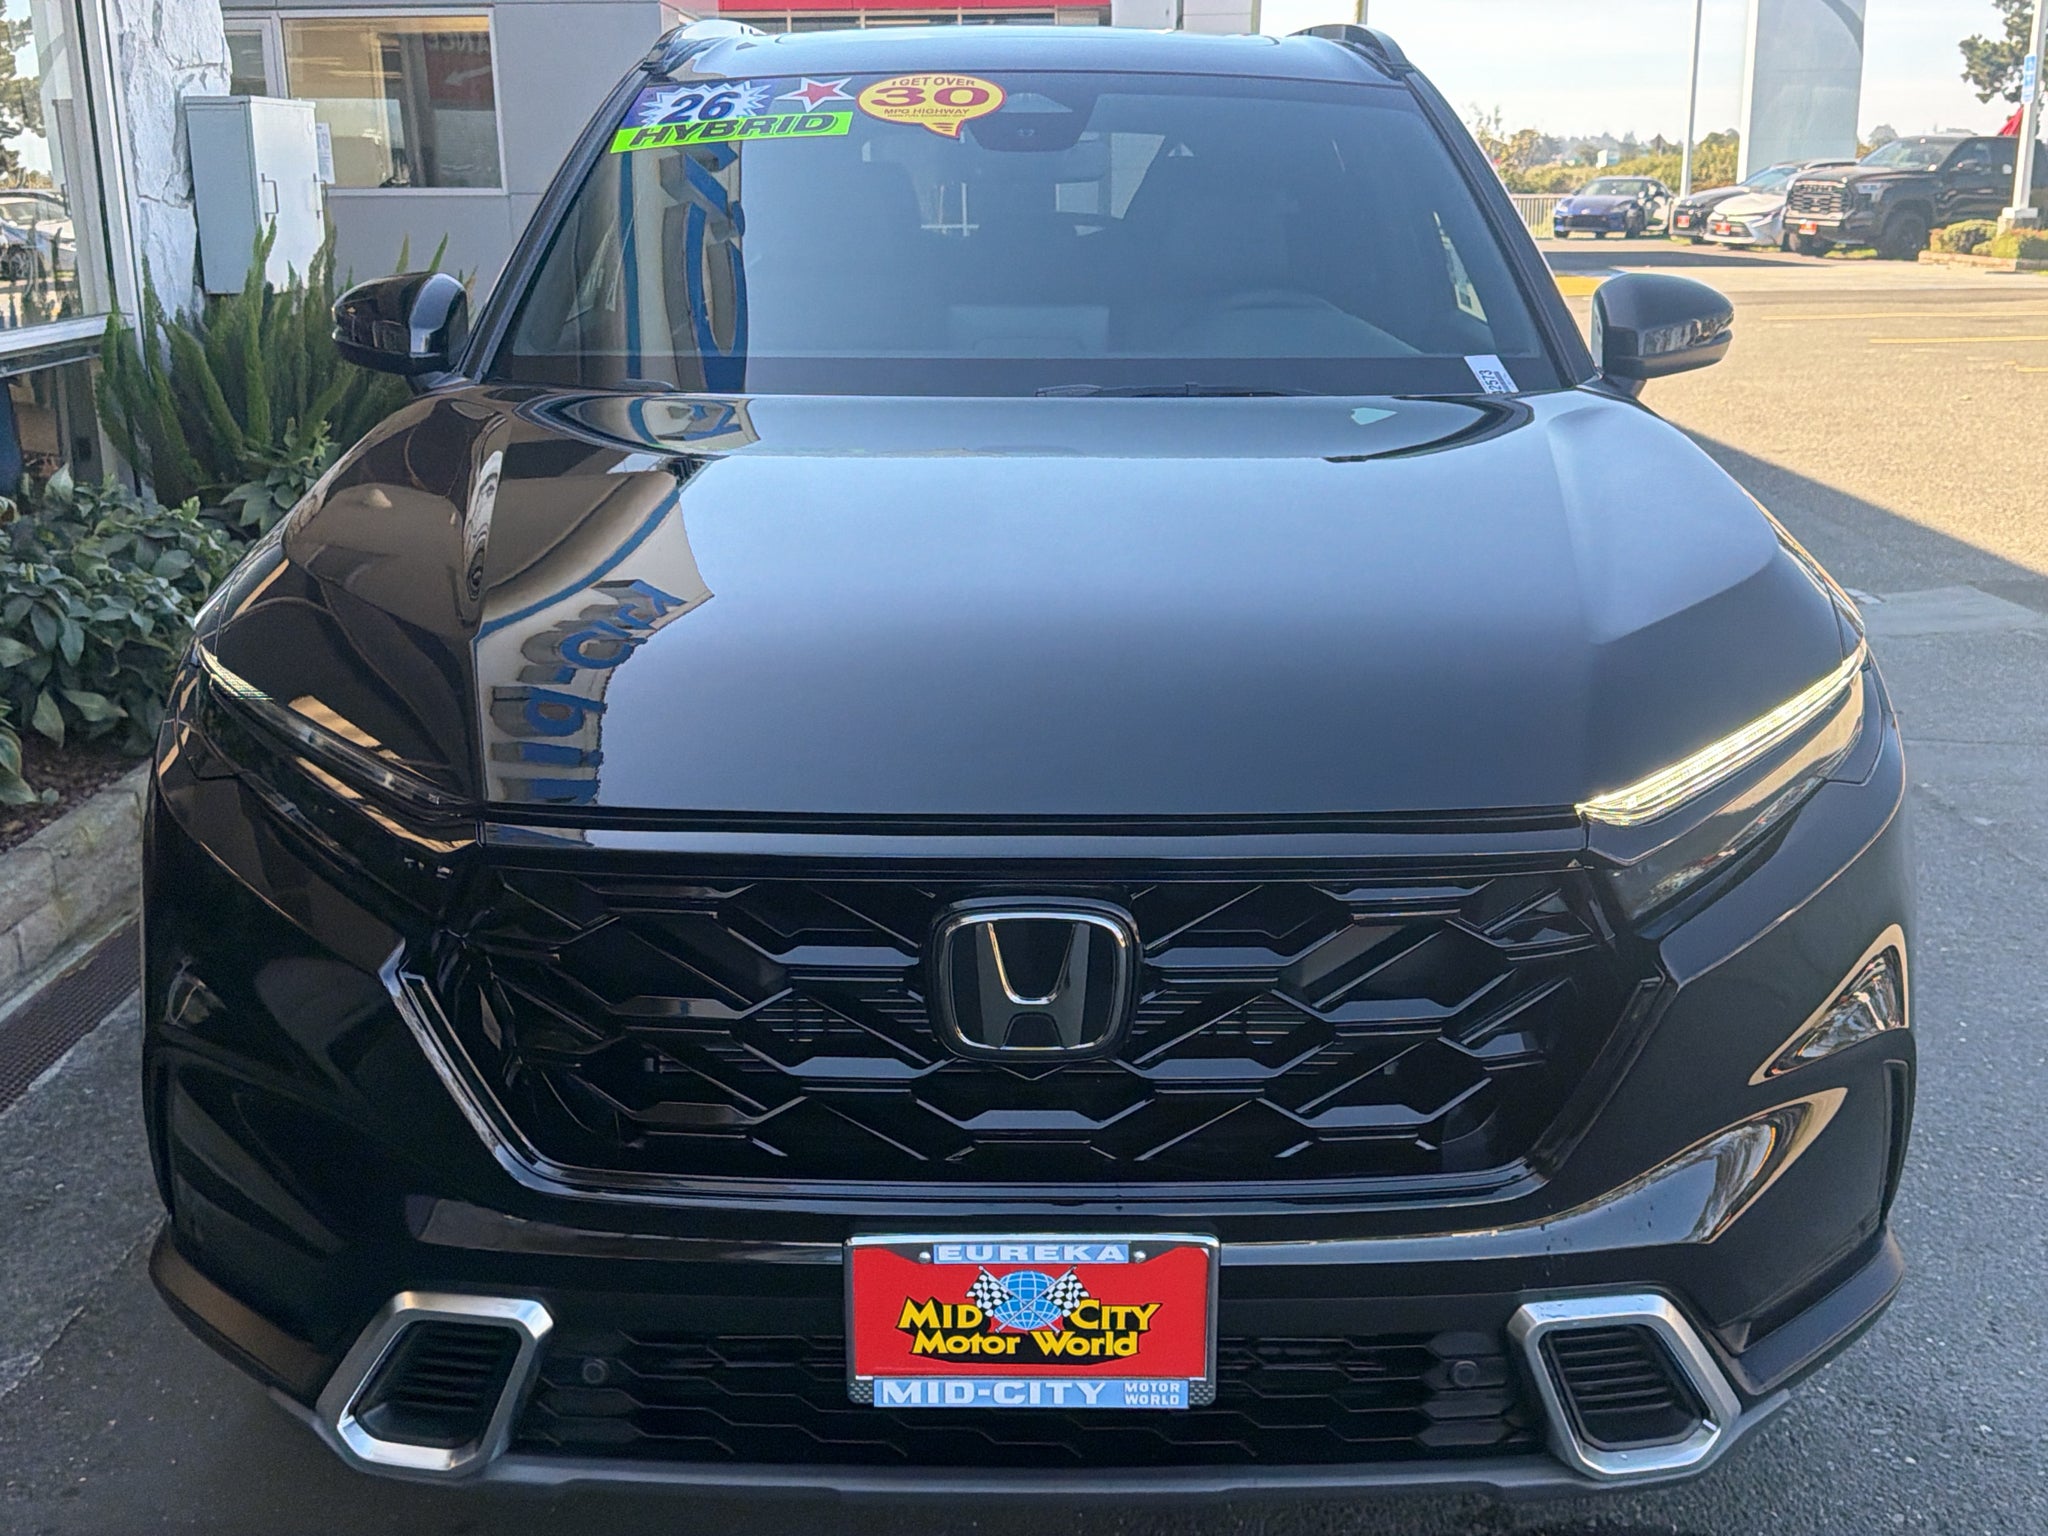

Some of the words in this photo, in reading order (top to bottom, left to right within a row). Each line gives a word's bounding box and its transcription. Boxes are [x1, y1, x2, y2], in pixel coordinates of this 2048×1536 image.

[900, 77, 932, 86] GET
[933, 77, 975, 86] OVER
[870, 86, 990, 107] 30
[657, 91, 741, 125] 26
[629, 113, 838, 147] HYBRID
[937, 1245, 1126, 1262] EUREKA
[898, 1298, 984, 1330] MID
[1069, 1299, 1162, 1330] CITY
[912, 1331, 1021, 1355] Motor
[1032, 1331, 1138, 1356] World
[881, 1381, 1107, 1405] MID-CITY
[1124, 1381, 1181, 1393] MOTOR
[1124, 1394, 1180, 1406] WORLD
